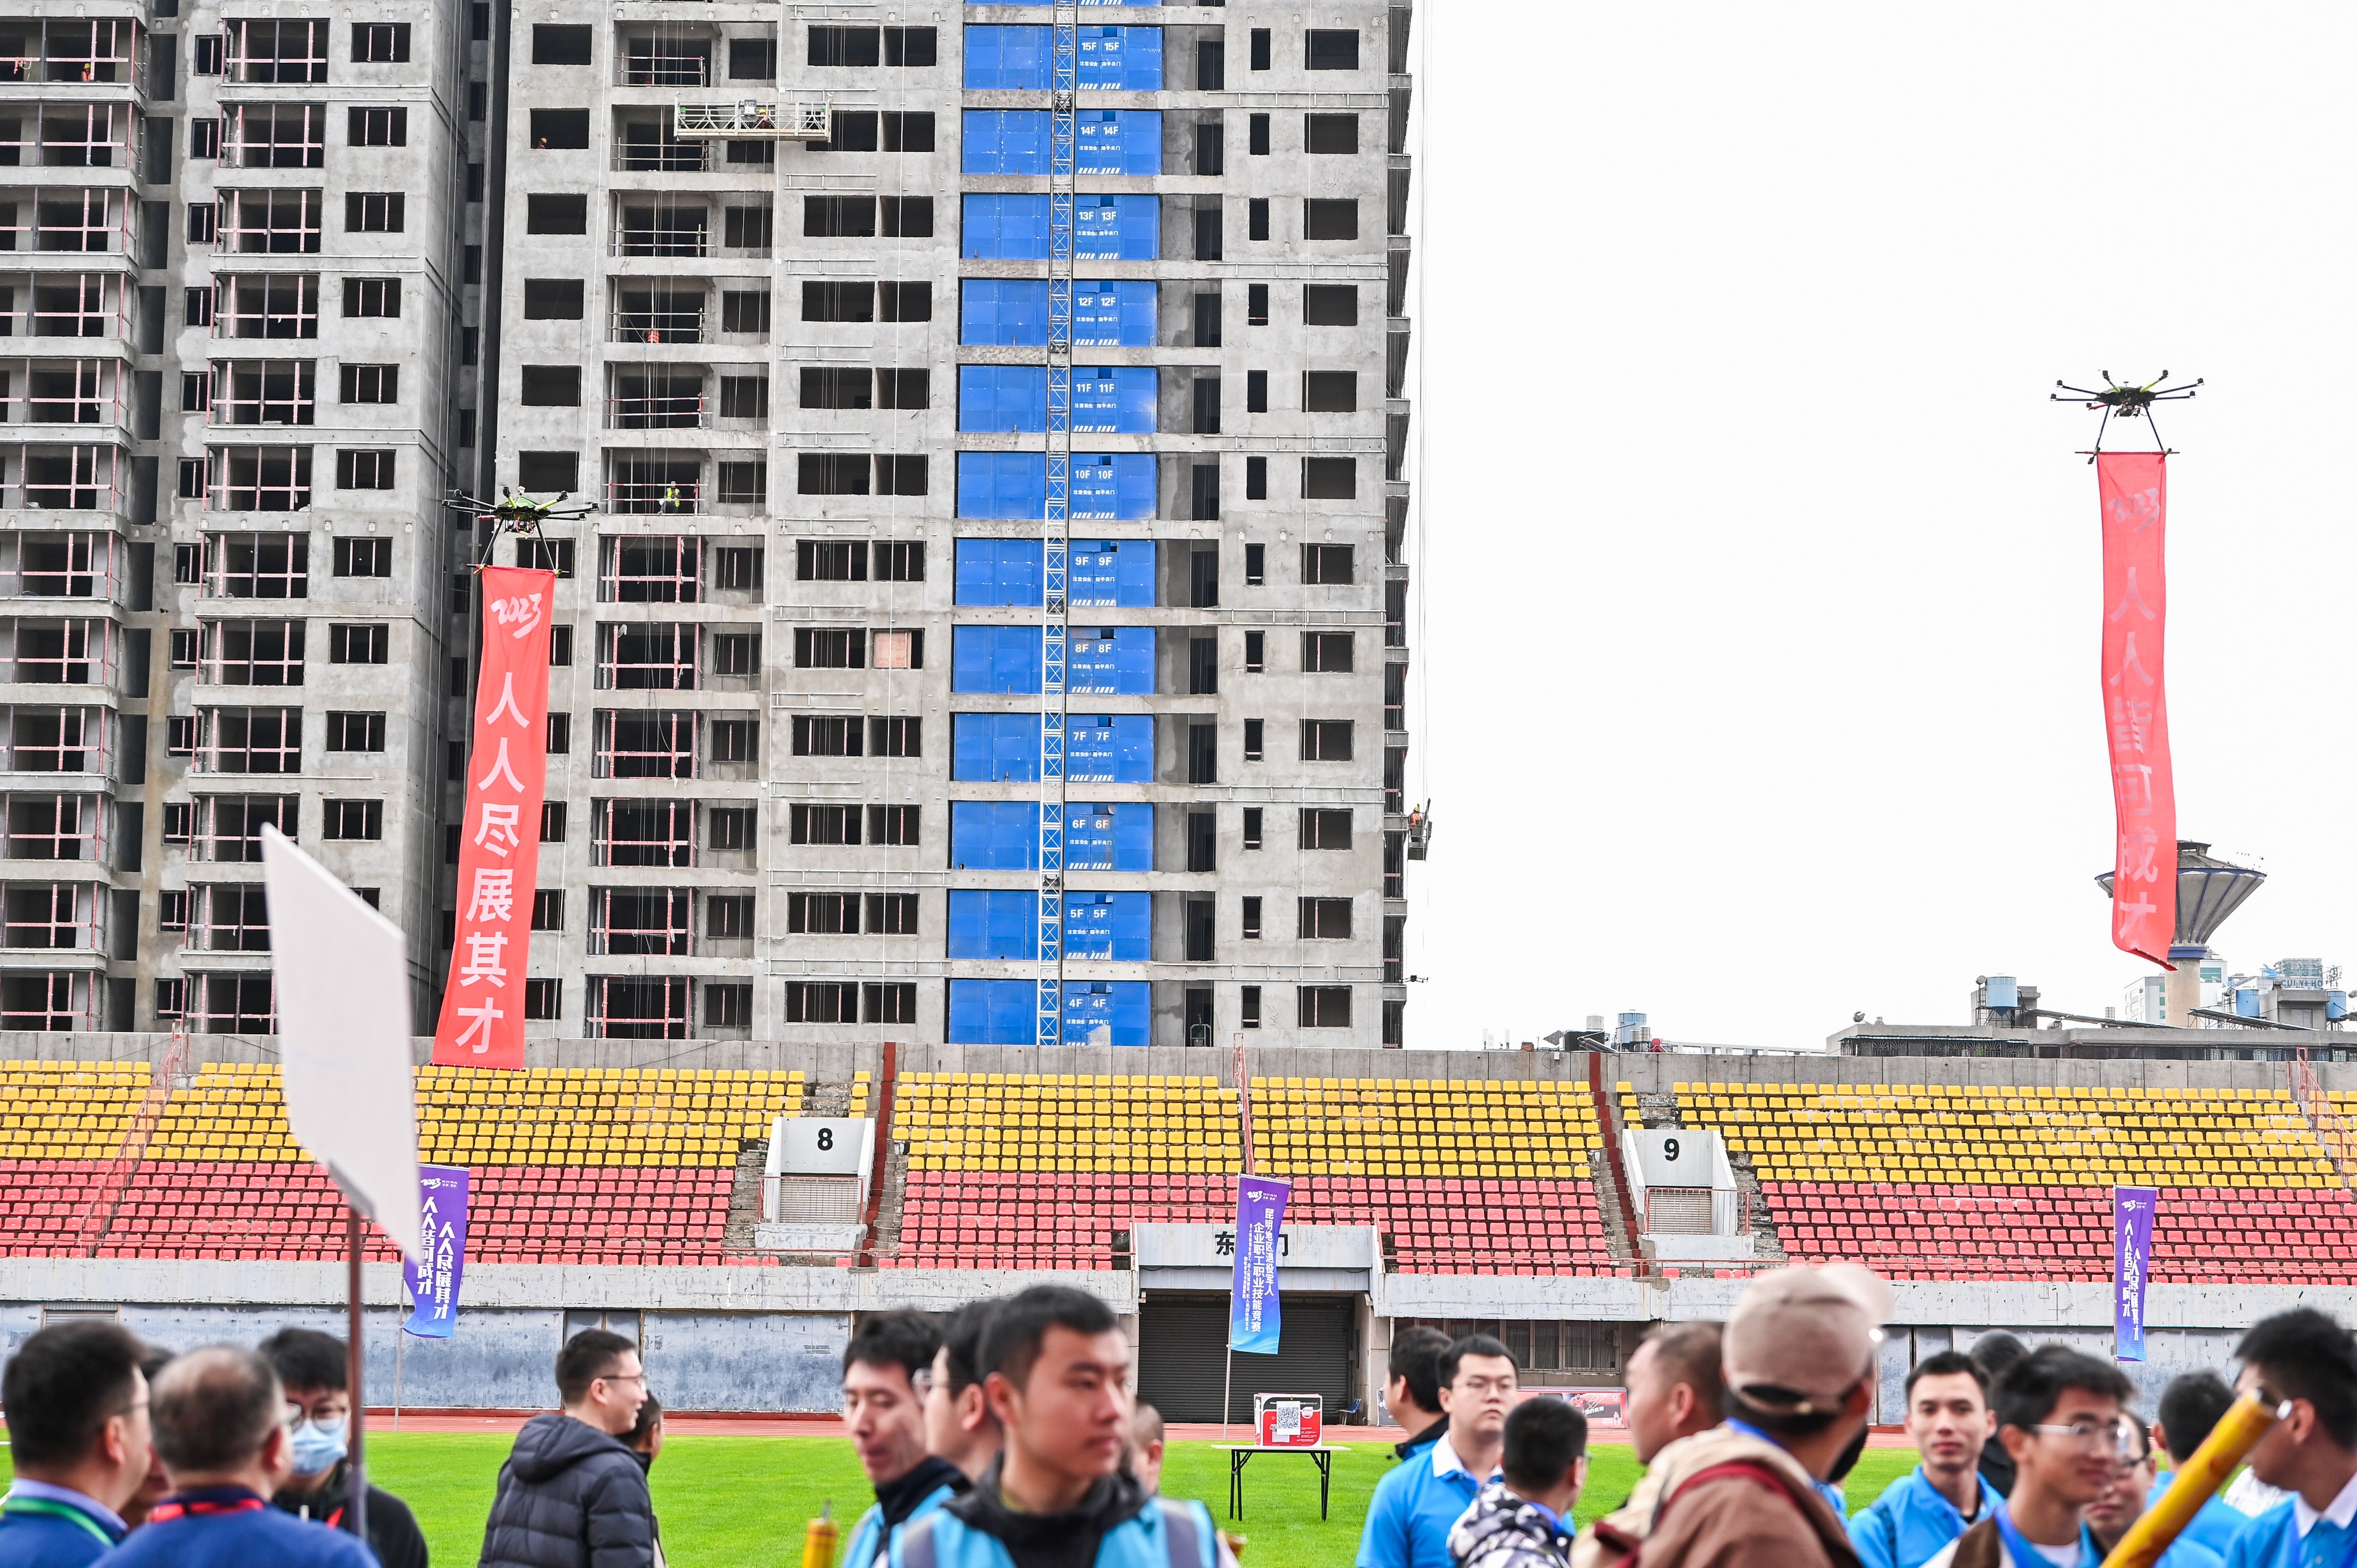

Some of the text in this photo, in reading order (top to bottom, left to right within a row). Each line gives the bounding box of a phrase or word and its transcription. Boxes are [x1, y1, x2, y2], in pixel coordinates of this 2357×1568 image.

[1081, 42, 1119, 51] 15F 15F
[1080, 126, 1119, 135] 14F 14F
[1078, 211, 1117, 221] 13F 13F
[1078, 297, 1116, 306] 12F 12F
[1076, 383, 1115, 393] 11F 11F
[1075, 470, 1113, 479] 10F 10F
[1075, 556, 1112, 566] 9F 9F
[490, 593, 542, 639] 2023
[1075, 643, 1112, 653] 8F 8F
[1073, 731, 1110, 741] 7F 7F
[2109, 567, 2159, 942] 人人皆可成才
[1072, 819, 1109, 829] 6F 6F
[455, 672, 530, 1054] 人人尽展其才
[1071, 909, 1107, 918] 5F 5F
[1069, 998, 1106, 1008] 4F 4F
[817, 1128, 833, 1151] 8
[1664, 1138, 1680, 1161] 9
[420, 1178, 441, 1189] 2023
[1247, 1190, 1263, 1202] 2023
[416, 1196, 438, 1295] 人人皆可成才
[1264, 1208, 1275, 1297] 昆明地区退役军人
[434, 1221, 455, 1319] 人人尽展其才
[1251, 1222, 1265, 1332] 企业职工职业技能竞赛
